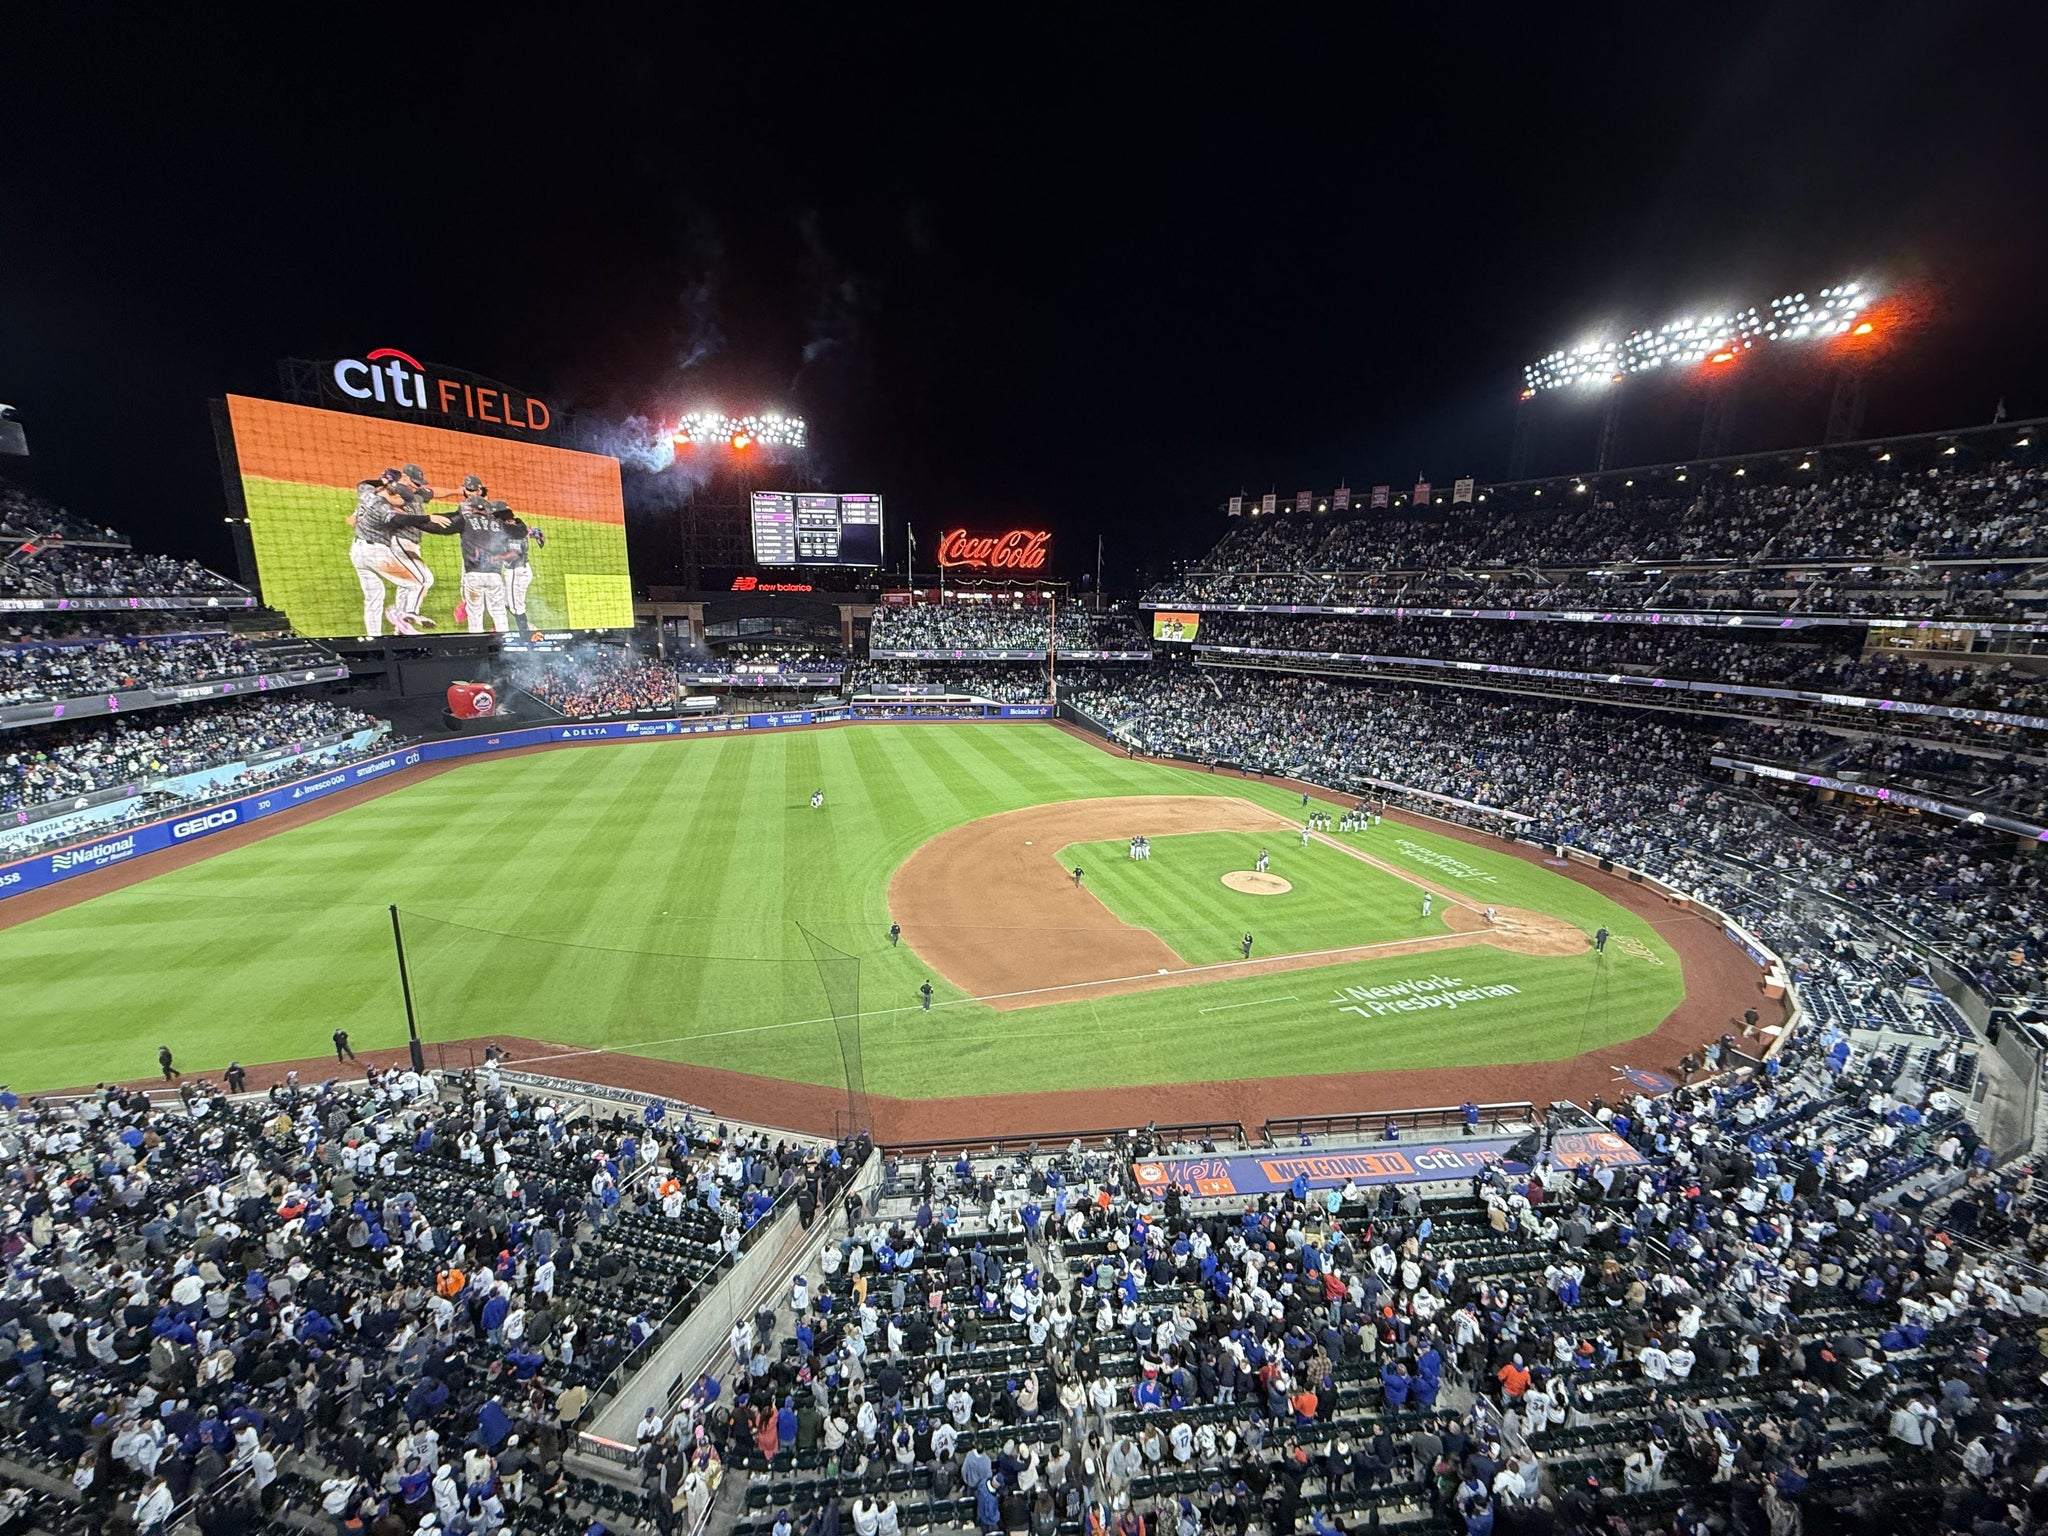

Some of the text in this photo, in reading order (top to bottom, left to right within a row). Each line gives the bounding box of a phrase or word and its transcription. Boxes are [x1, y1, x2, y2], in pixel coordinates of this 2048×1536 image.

[334, 358, 550, 431] citi FIELD
[938, 529, 1051, 568] Coca-Cola
[776, 583, 812, 591] balance
[573, 728, 607, 736] DELTA
[405, 753, 420, 765] citi
[356, 759, 391, 777] smartwater
[304, 780, 331, 793] Invesco
[258, 800, 271, 810] 370
[31, 822, 60, 835] FIESTA
[173, 808, 237, 838] GEICO
[72, 835, 136, 865] National
[95, 849, 133, 865] Car Rental
[1366, 983, 1522, 1016] Presbyterian
[1271, 1150, 1514, 1180] WELCOME TO citi FIEL
[1533, 1402, 1545, 1412] 34
[1181, 1435, 1189, 1448] 17
[416, 1445, 428, 1454] 12
